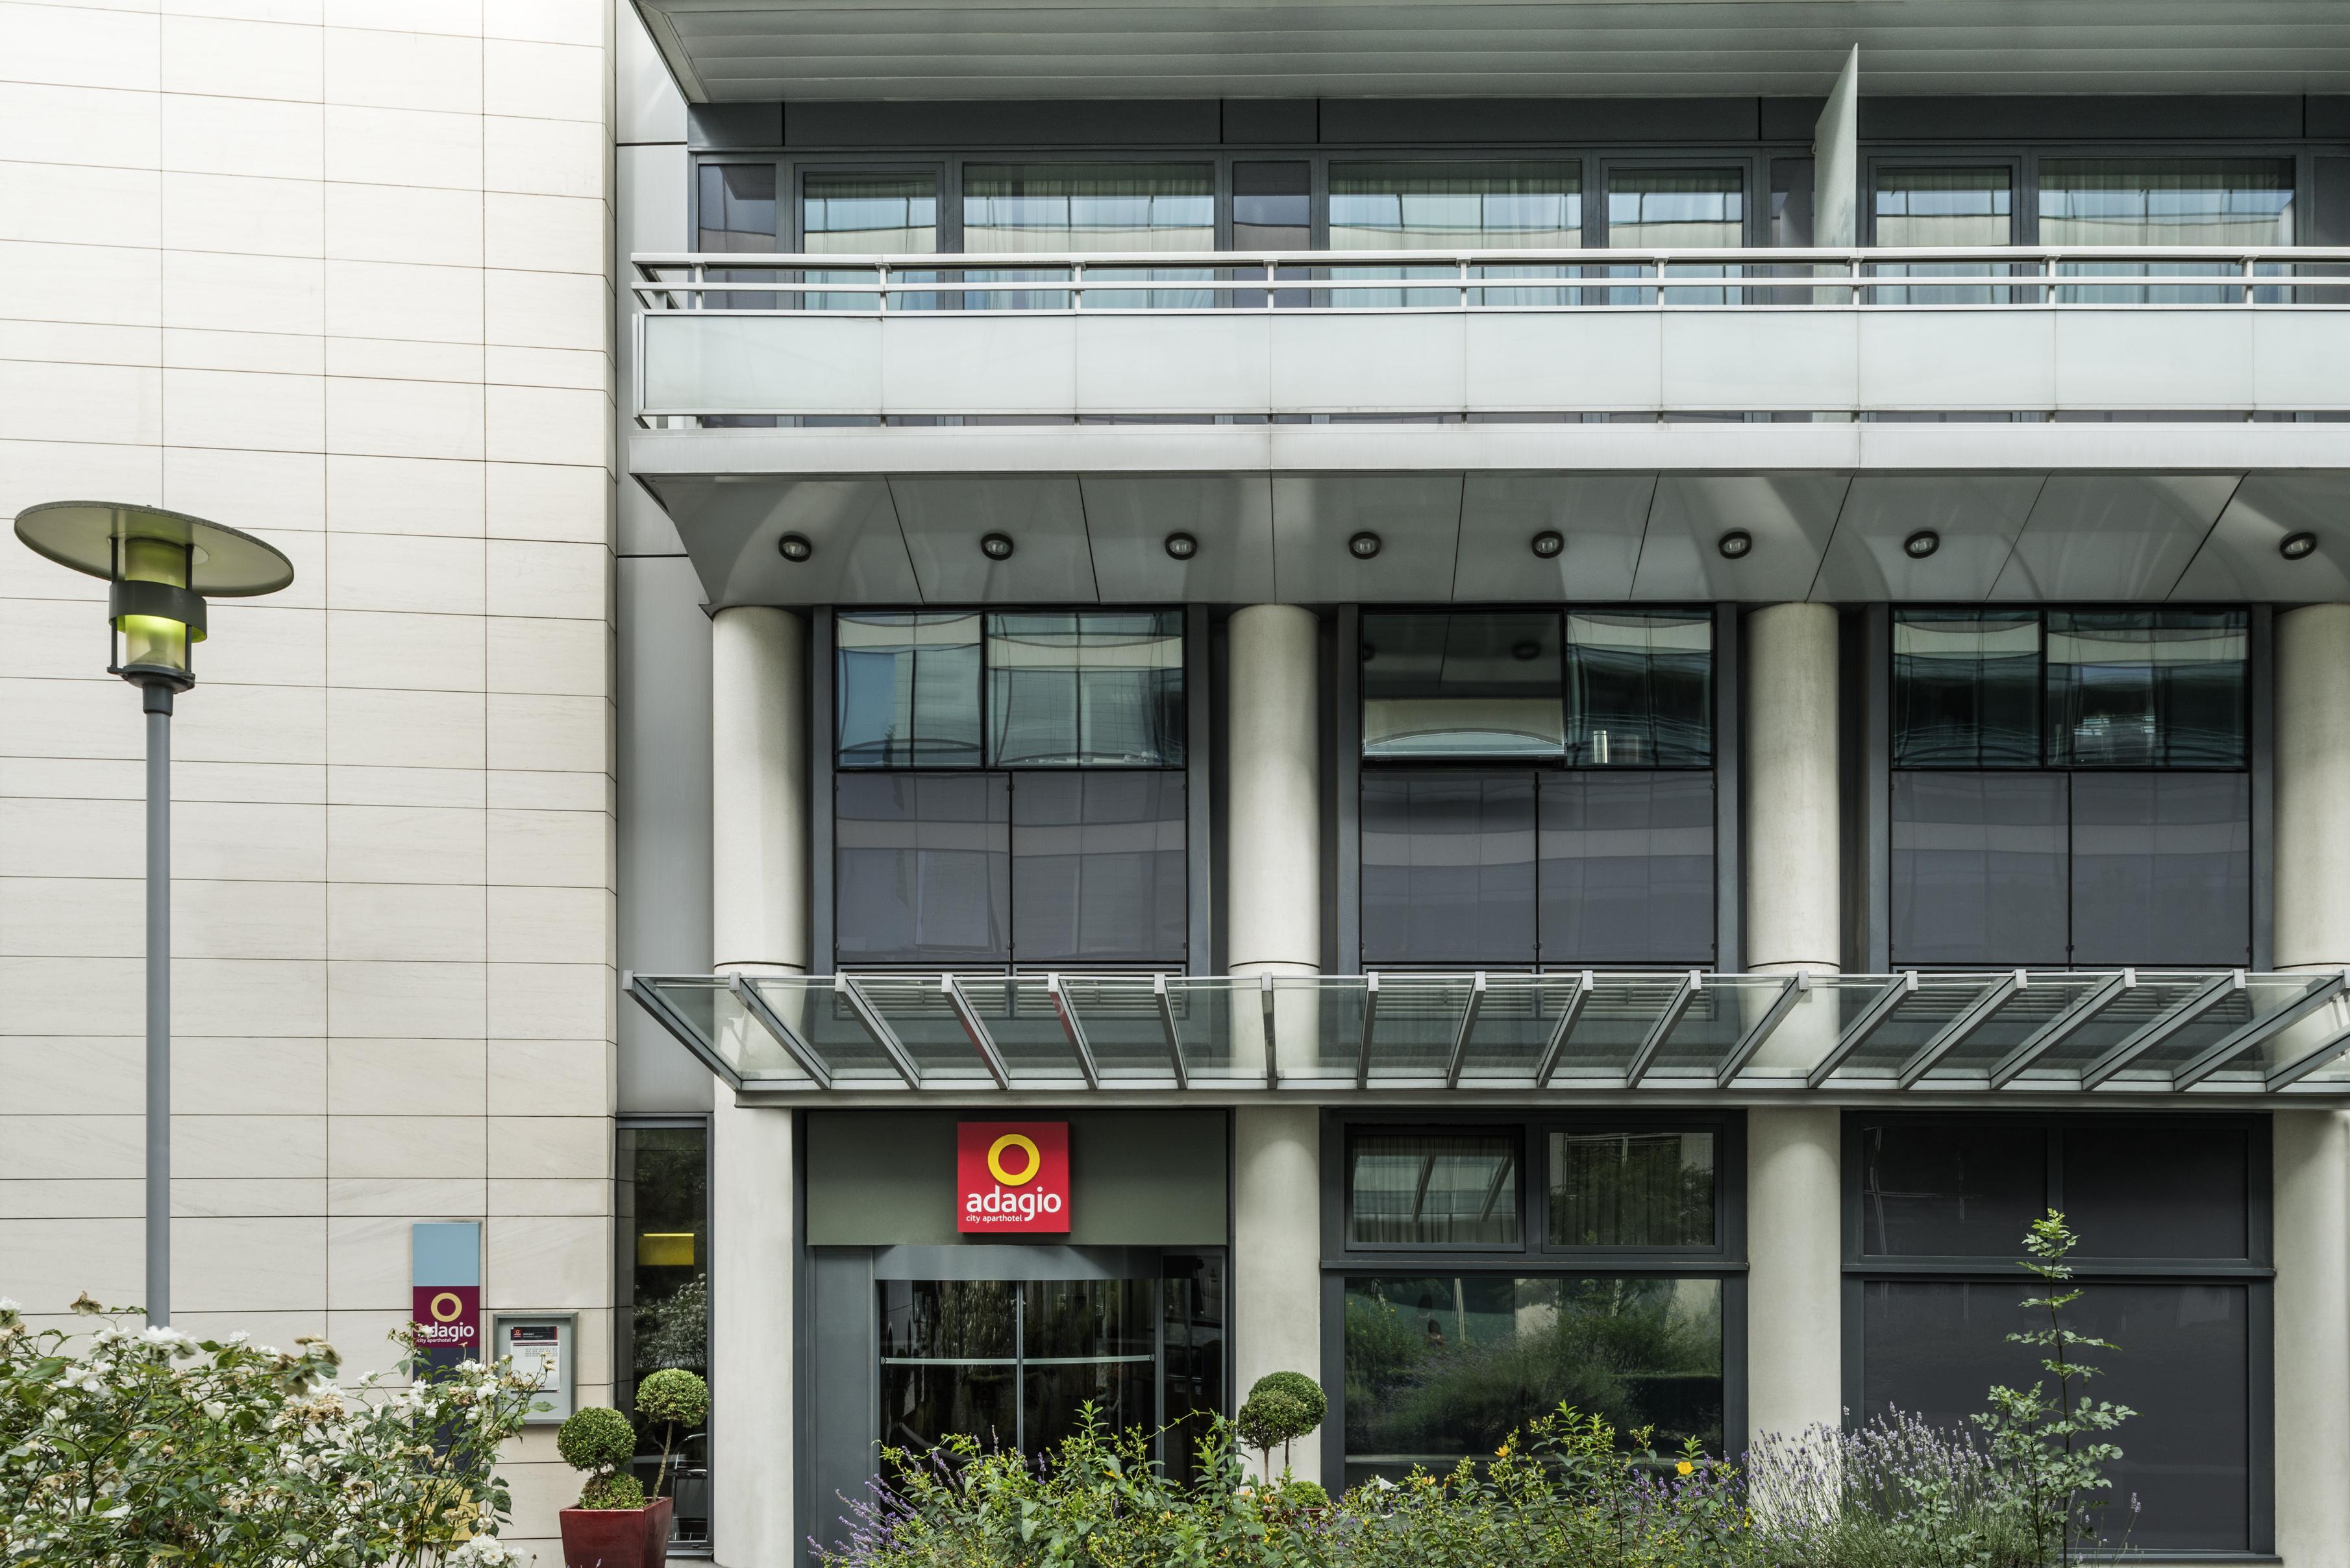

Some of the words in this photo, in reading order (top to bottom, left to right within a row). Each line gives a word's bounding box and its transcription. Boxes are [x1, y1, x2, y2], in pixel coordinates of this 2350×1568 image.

[966, 1184, 1061, 1221] adagio
[966, 1215, 980, 1223] city
[982, 1214, 1022, 1223] aparthotel
[417, 1321, 475, 1342] dagio
